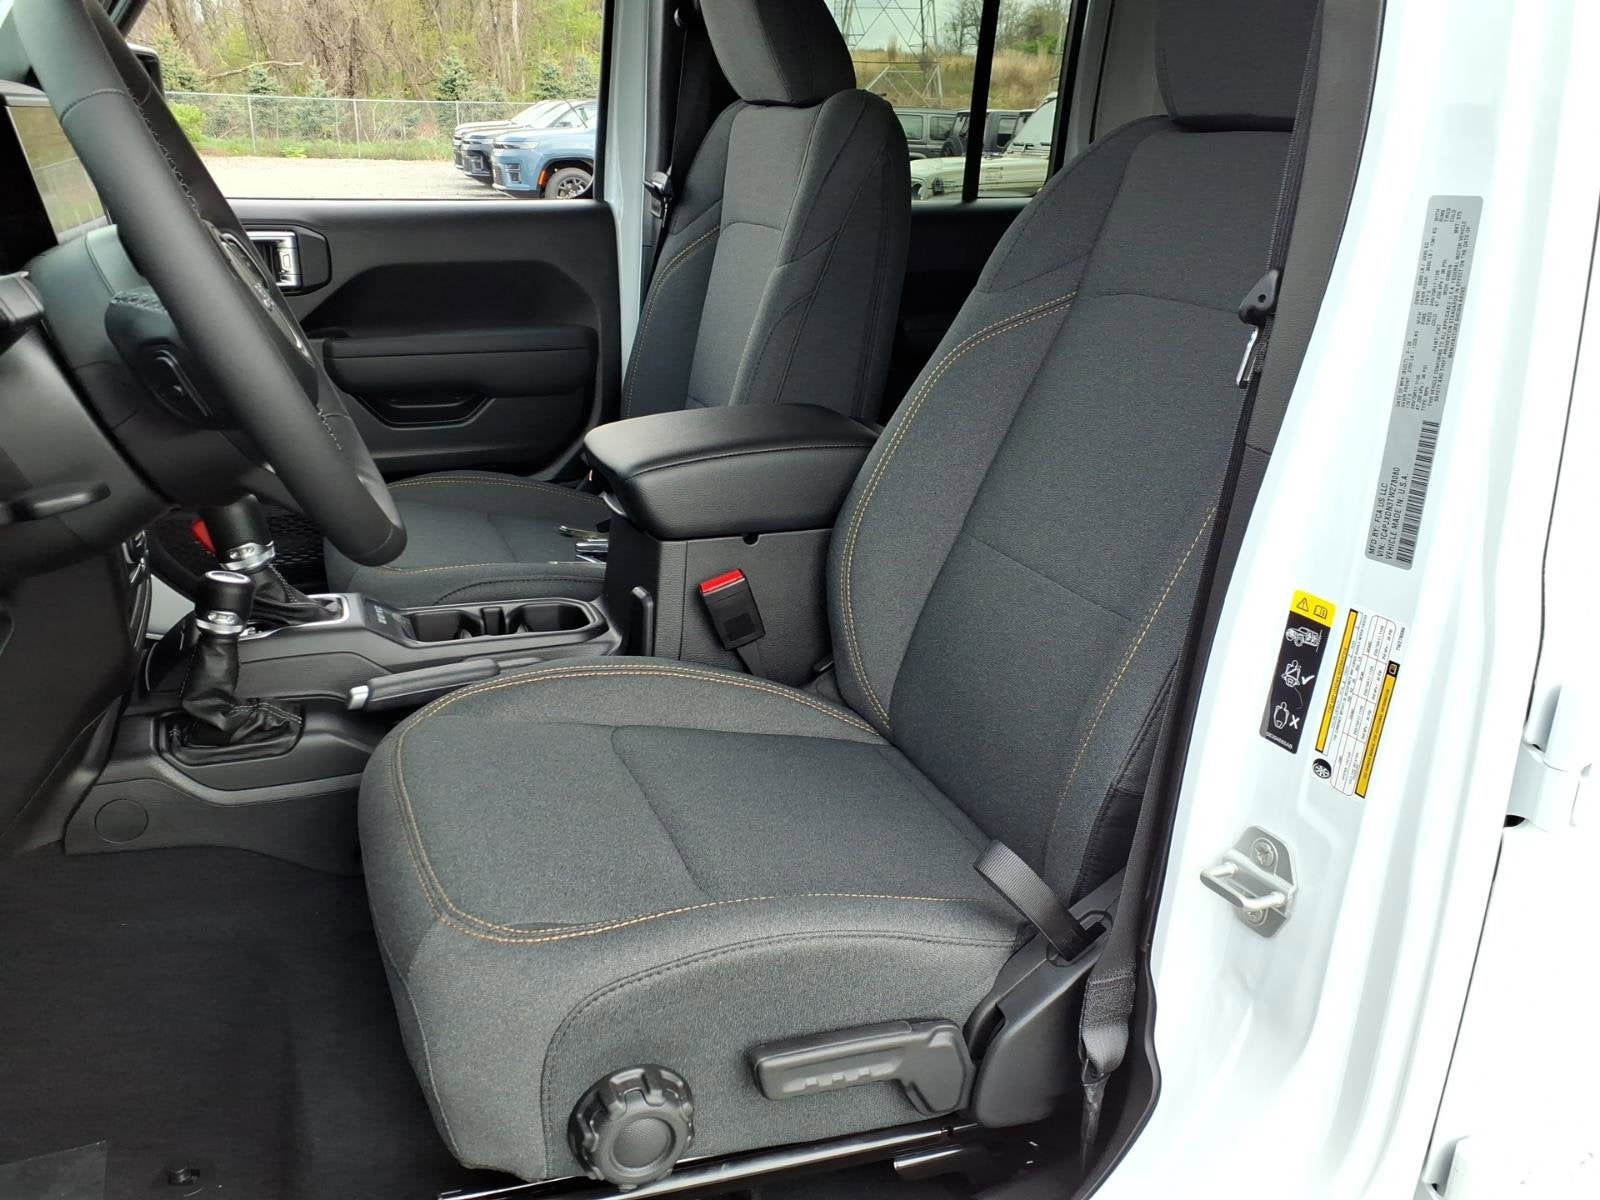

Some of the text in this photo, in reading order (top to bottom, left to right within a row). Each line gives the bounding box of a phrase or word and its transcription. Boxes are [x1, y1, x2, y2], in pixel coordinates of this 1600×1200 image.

[1368, 482, 1387, 554] MFD BY: FCA US LLC
[1377, 542, 1386, 558] VIN:
[1385, 472, 1408, 560] VEHICLE MADE IN: U.S.A.
